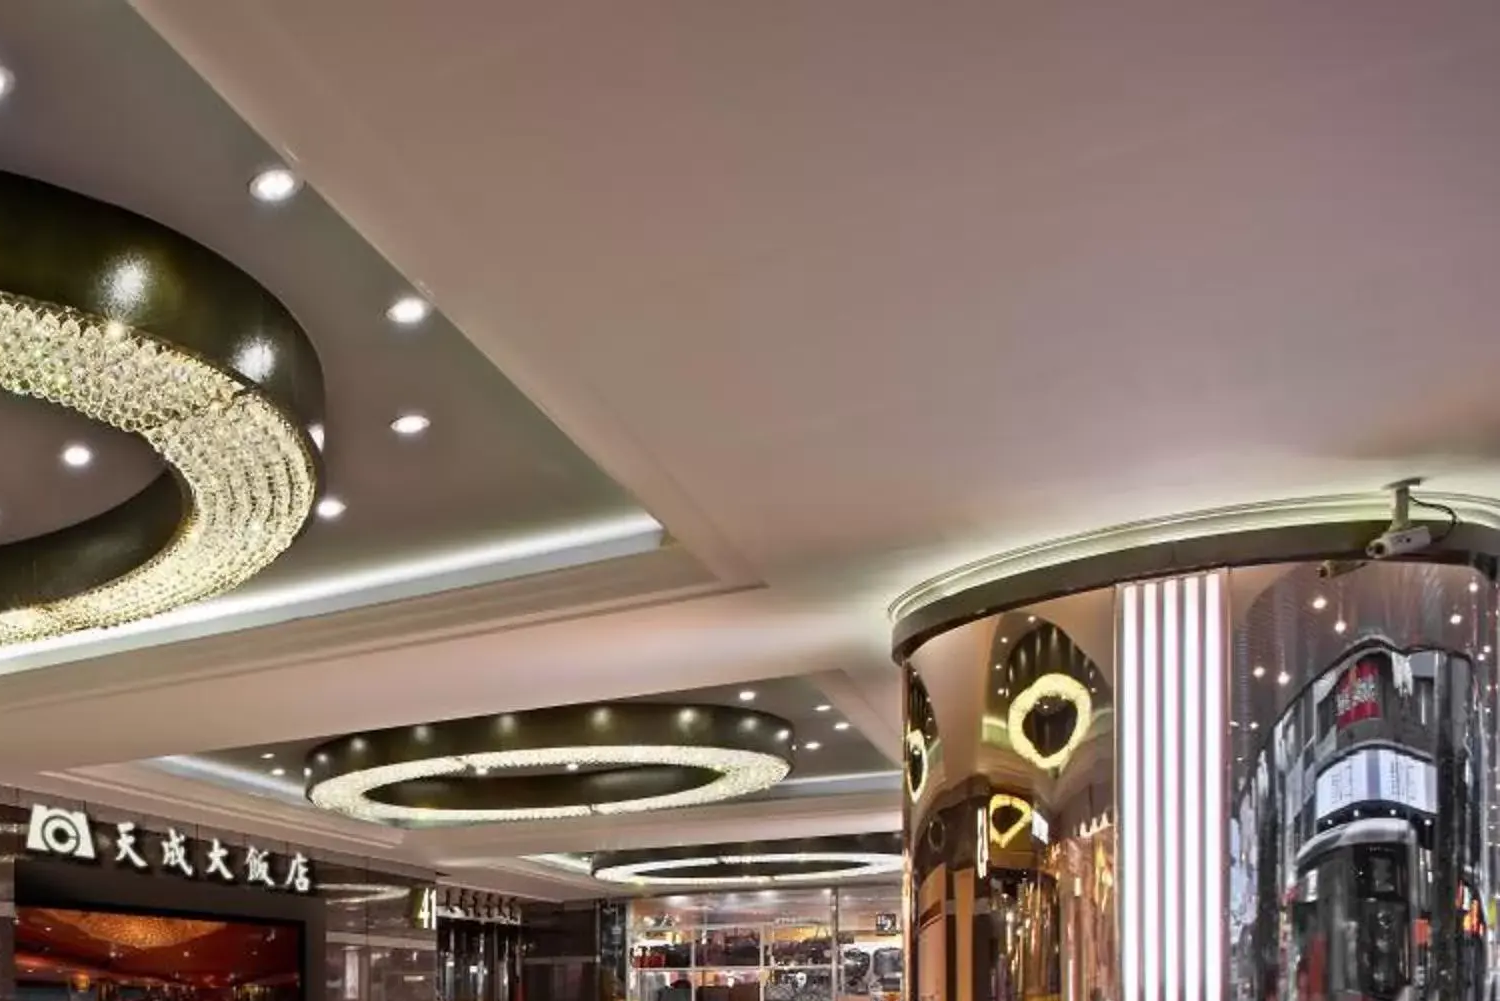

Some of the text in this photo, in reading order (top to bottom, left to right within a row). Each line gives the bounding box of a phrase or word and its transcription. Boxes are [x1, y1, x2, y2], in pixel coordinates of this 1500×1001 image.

[115, 821, 312, 892] 天成大飯店
[418, 887, 437, 931] 41
